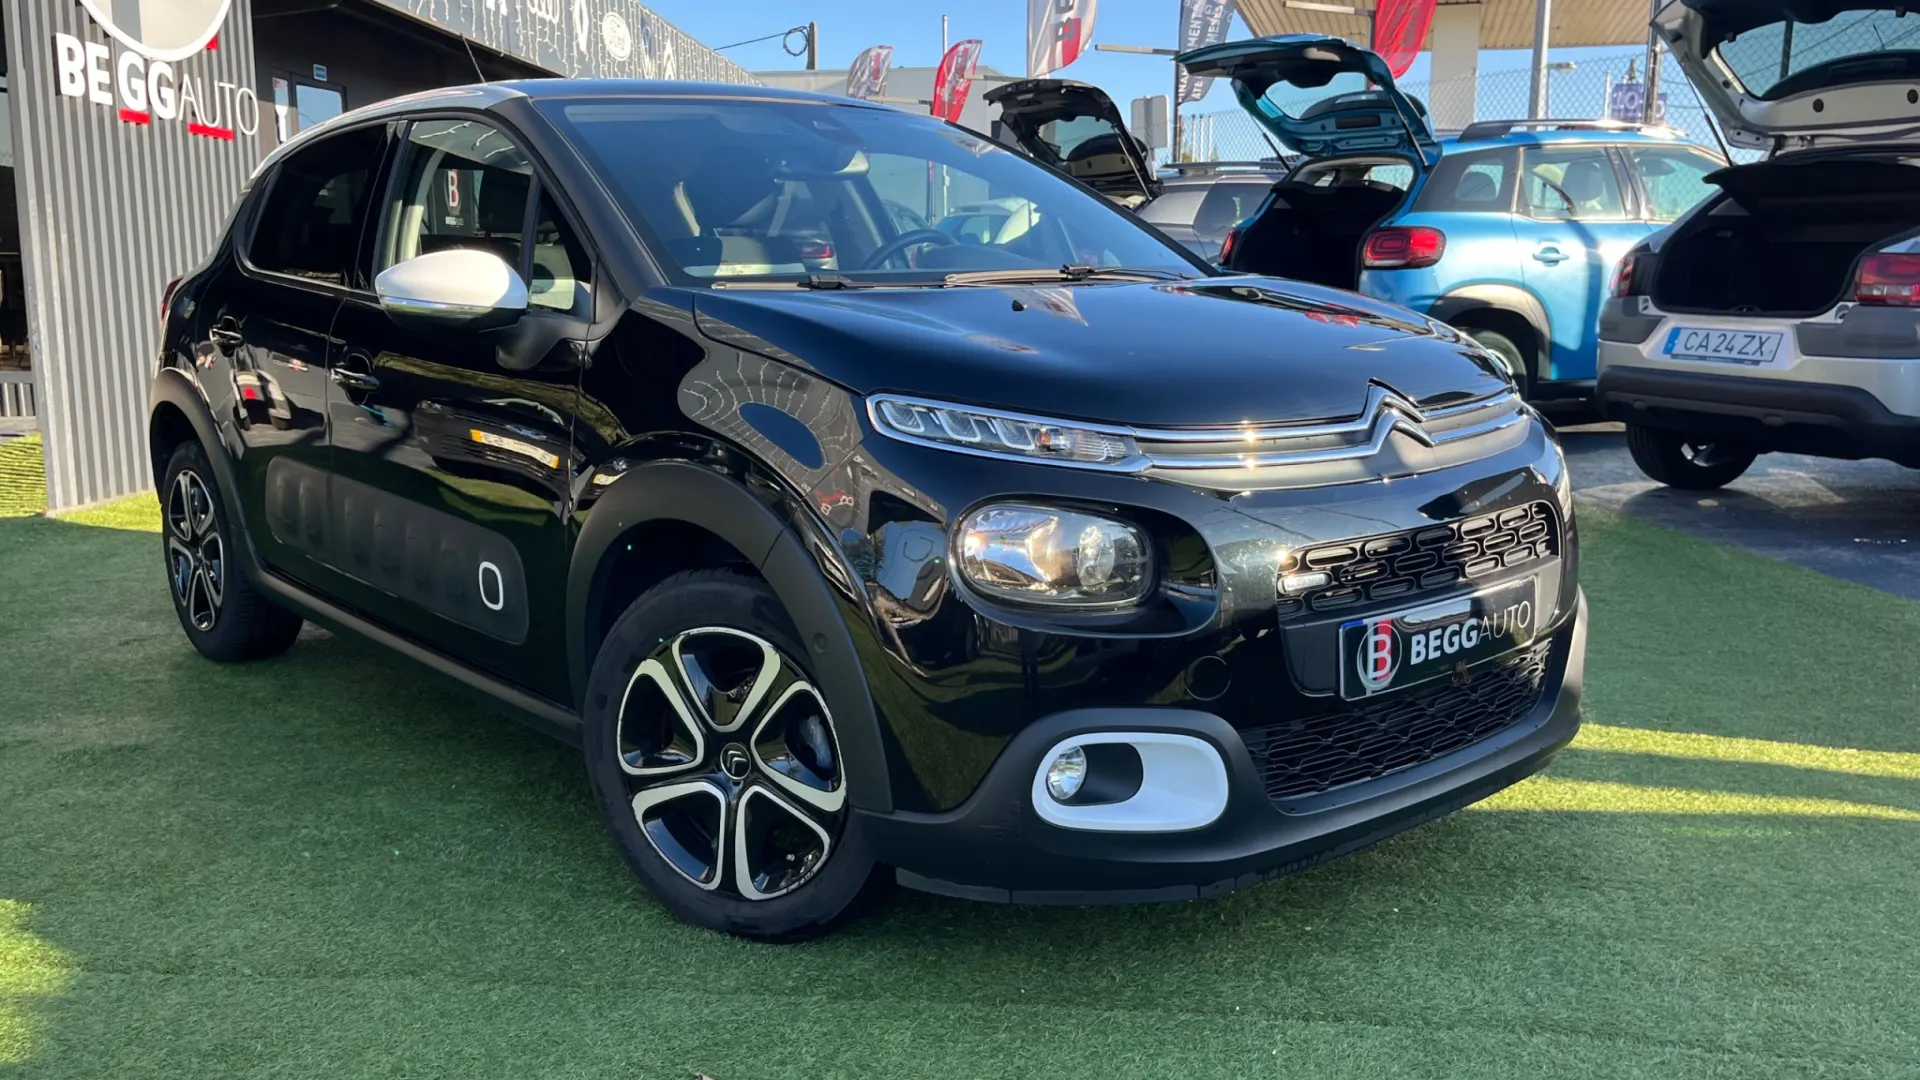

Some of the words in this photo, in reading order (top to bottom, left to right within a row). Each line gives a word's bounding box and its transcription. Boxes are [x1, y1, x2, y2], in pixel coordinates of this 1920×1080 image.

[56, 32, 259, 136] BEGGAUTO
[1684, 331, 1710, 353] CA
[1712, 333, 1737, 354] 24
[1737, 334, 1771, 357] ZX
[1369, 633, 1392, 680] B
[1410, 600, 1531, 666] BEGGAUTO
